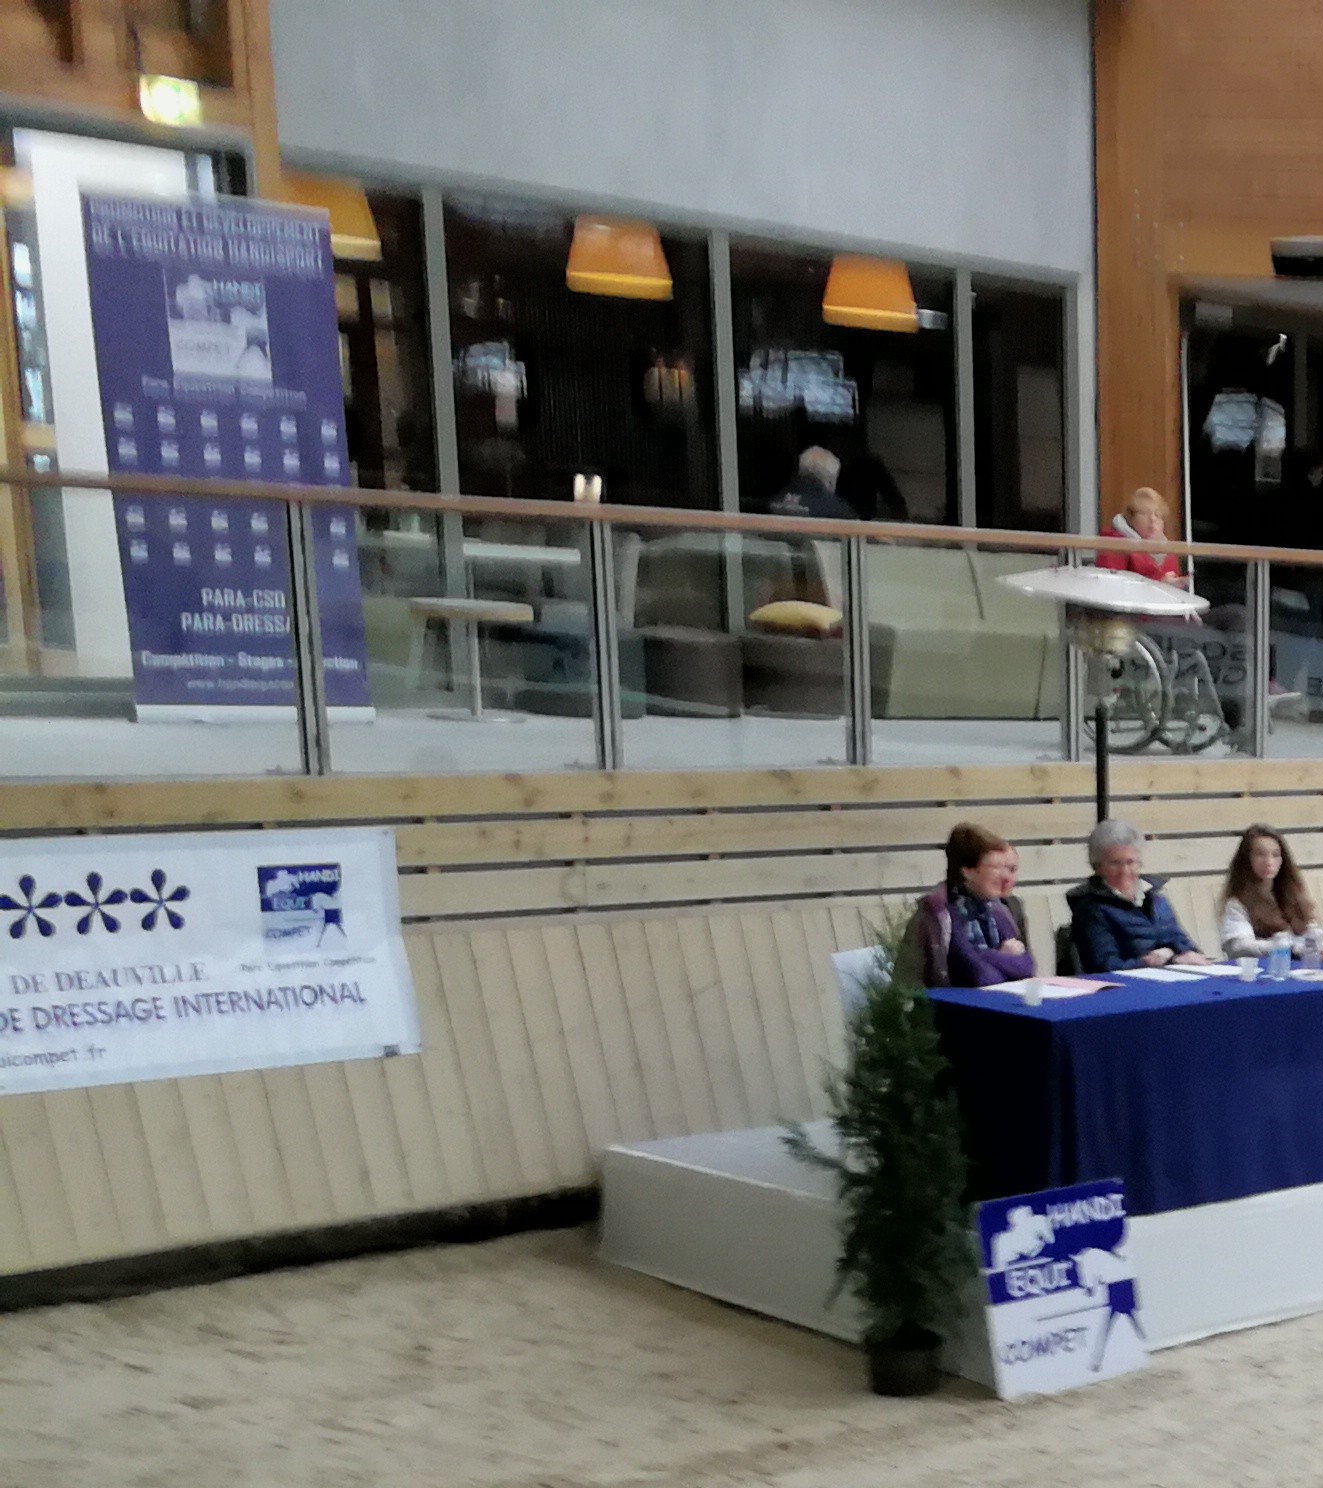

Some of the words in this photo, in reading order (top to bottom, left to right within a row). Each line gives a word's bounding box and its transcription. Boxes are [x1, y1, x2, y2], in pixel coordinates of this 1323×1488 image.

[180, 611, 291, 634] PARA-DRESS
[11, 974, 48, 994] DE
[55, 962, 208, 992] DEAUVILLE
[32, 997, 168, 1031] DRESSAGE
[173, 981, 367, 1019] INTERNATIONAL
[1046, 1192, 1127, 1229] HANDI
[1005, 1261, 1074, 1298] EQUI
[1001, 1325, 1090, 1365] COMPET
